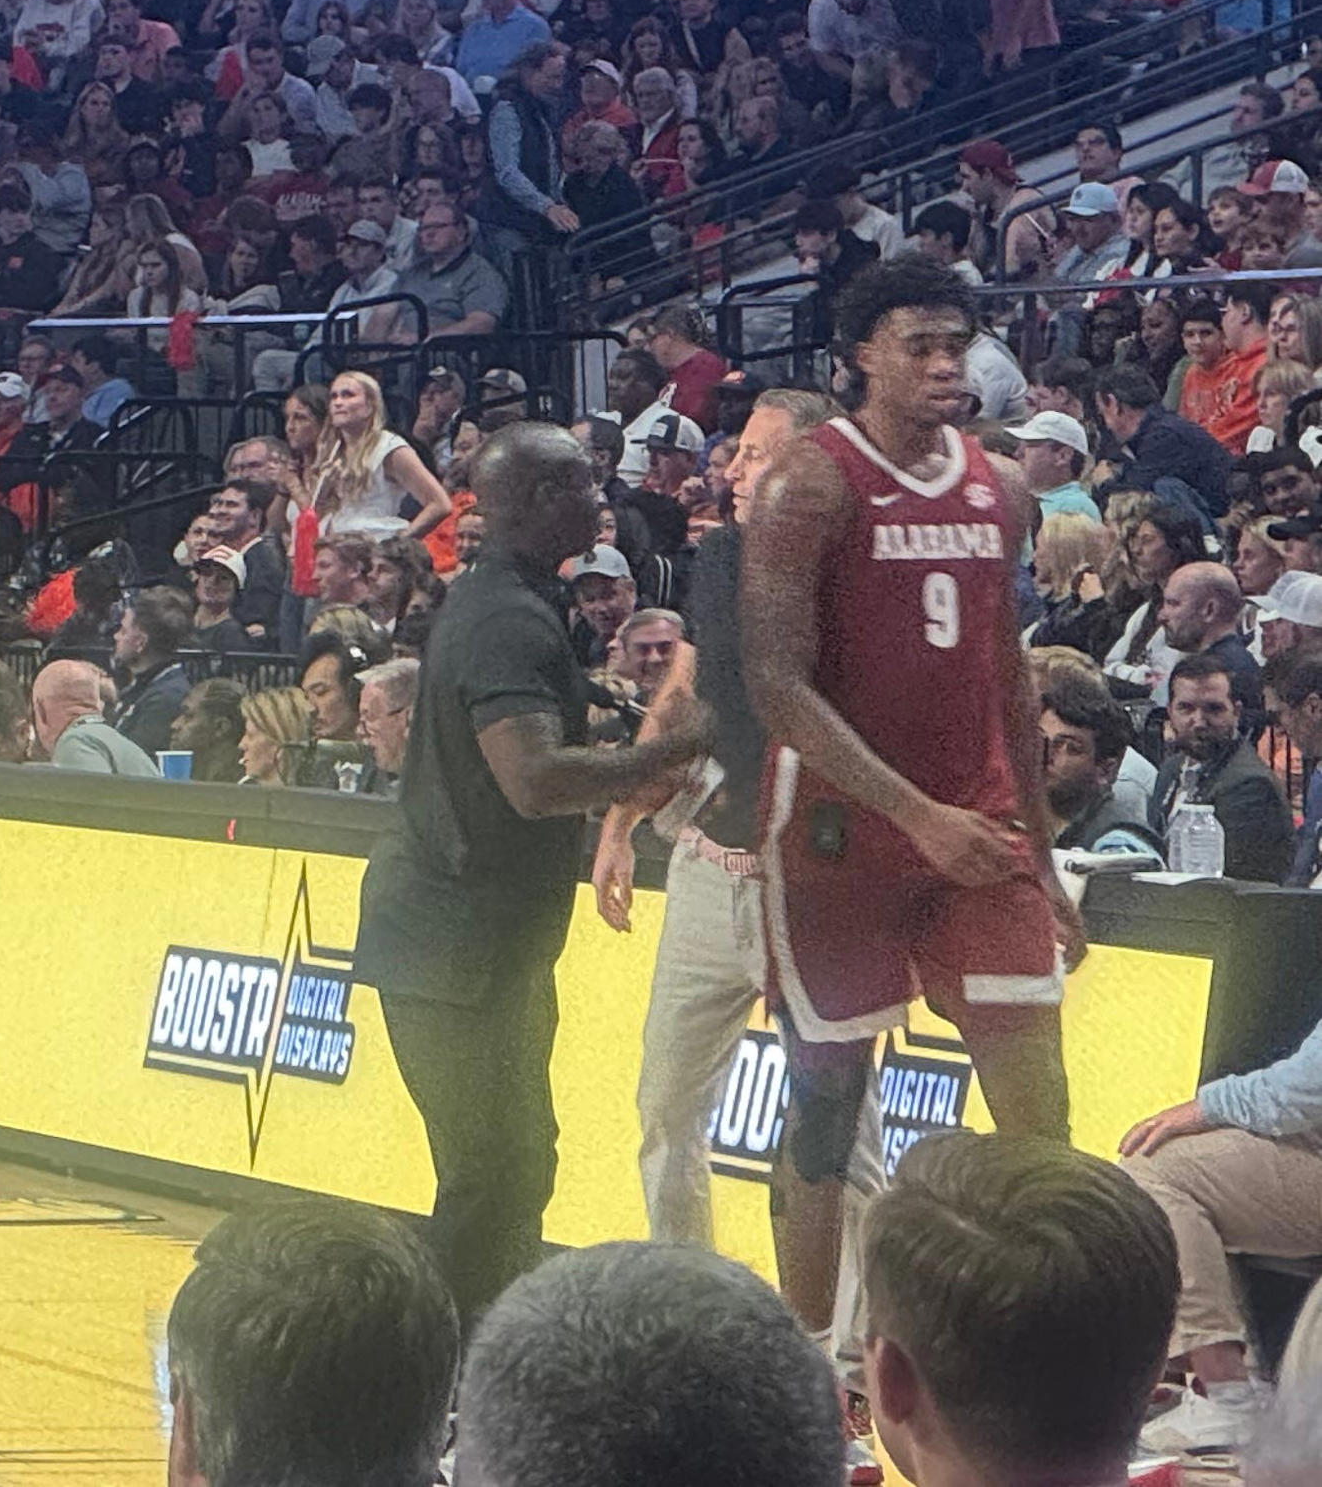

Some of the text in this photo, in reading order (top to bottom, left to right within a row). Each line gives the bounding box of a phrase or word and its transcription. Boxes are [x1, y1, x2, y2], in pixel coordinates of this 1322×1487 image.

[923, 571, 960, 648] 9
[151, 954, 279, 1057] BOOSTR
[285, 975, 346, 1023] DIGITAL
[275, 1022, 352, 1076] DISPLAYS
[879, 1066, 959, 1127] DIGITAL
